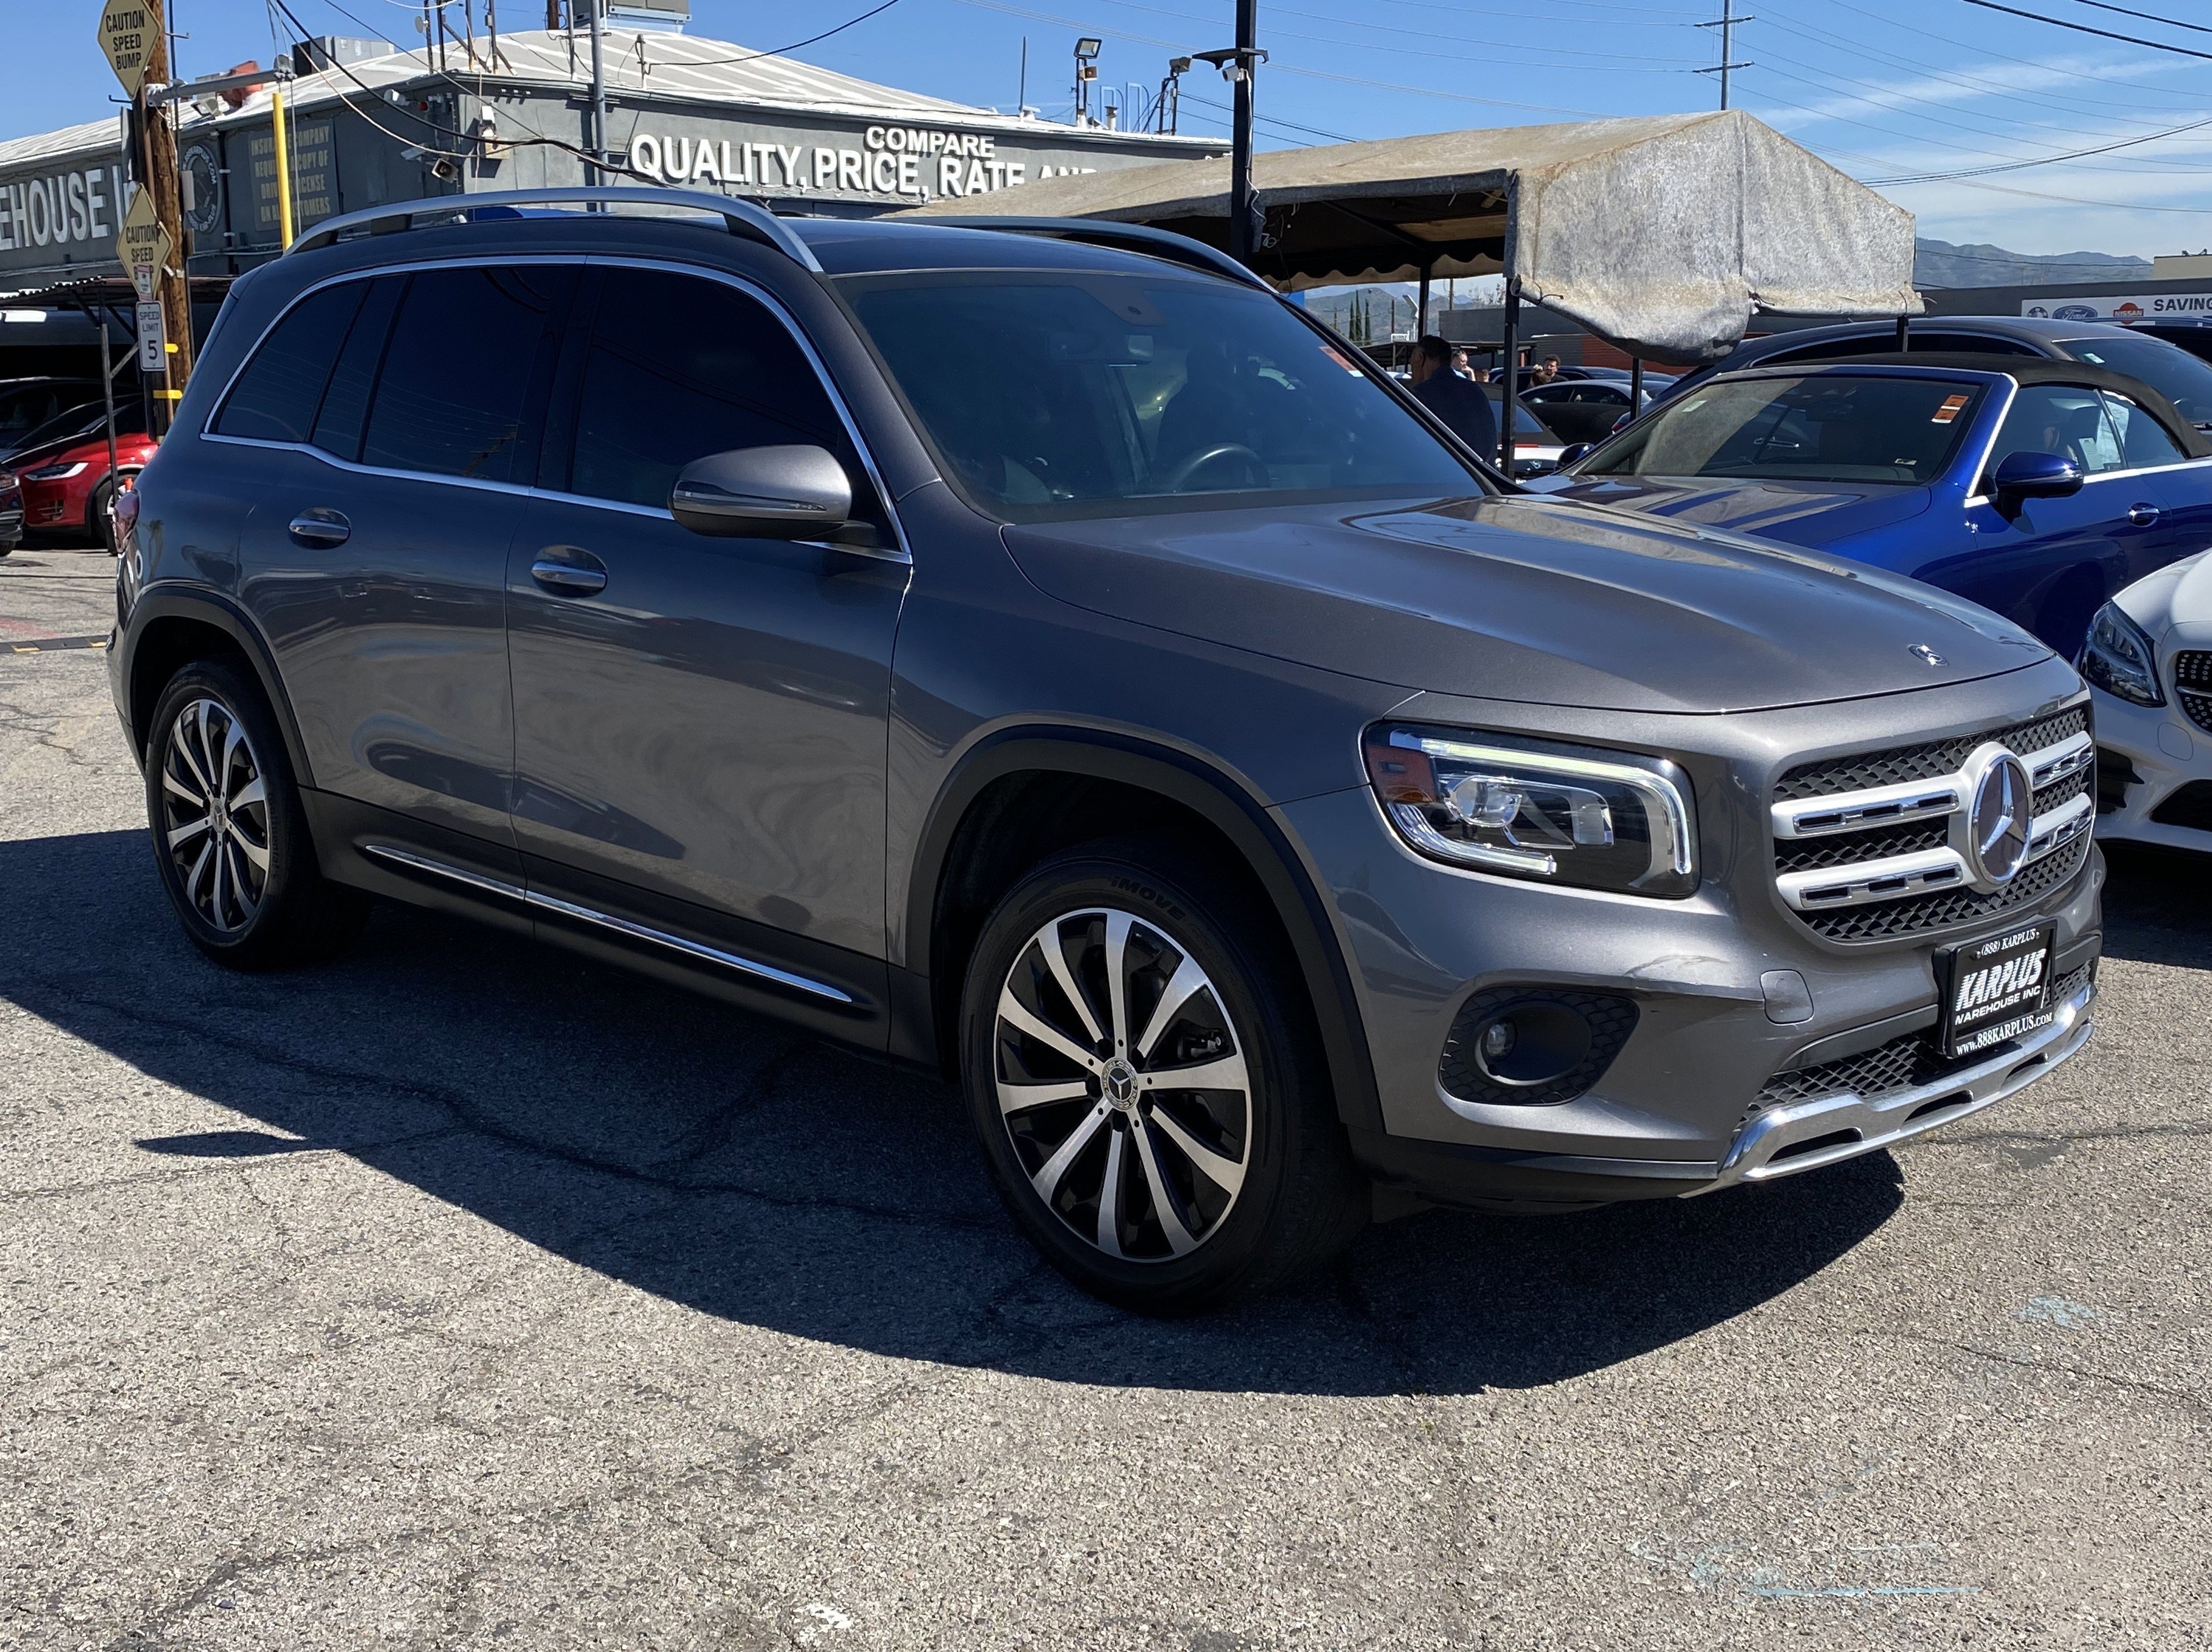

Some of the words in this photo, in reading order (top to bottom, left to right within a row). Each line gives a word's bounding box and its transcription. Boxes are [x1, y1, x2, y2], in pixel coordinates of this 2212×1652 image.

[106, 9, 145, 33] CAUTION
[113, 33, 141, 52] SPEED
[116, 52, 141, 70] BUMP
[866, 125, 995, 158] COMPARE
[297, 152, 317, 171] COPY
[318, 150, 328, 167] OF
[631, 134, 808, 194] QUALITY,
[814, 147, 929, 203] PRICE,
[939, 157, 1026, 196] RATE
[126, 226, 157, 244] CAUTION
[131, 247, 153, 263] SPEED
[134, 266, 154, 280] BP
[139, 311, 160, 320] SPEED
[2062, 308, 2088, 320] Ford
[142, 323, 159, 332] LIMIT
[147, 340, 158, 360] 5
[1981, 940, 2000, 957] (888)
[2001, 928, 2036, 950] KARPLUS
[1955, 948, 2047, 1012] KARPLUS
[2023, 986, 2041, 1000] INC
